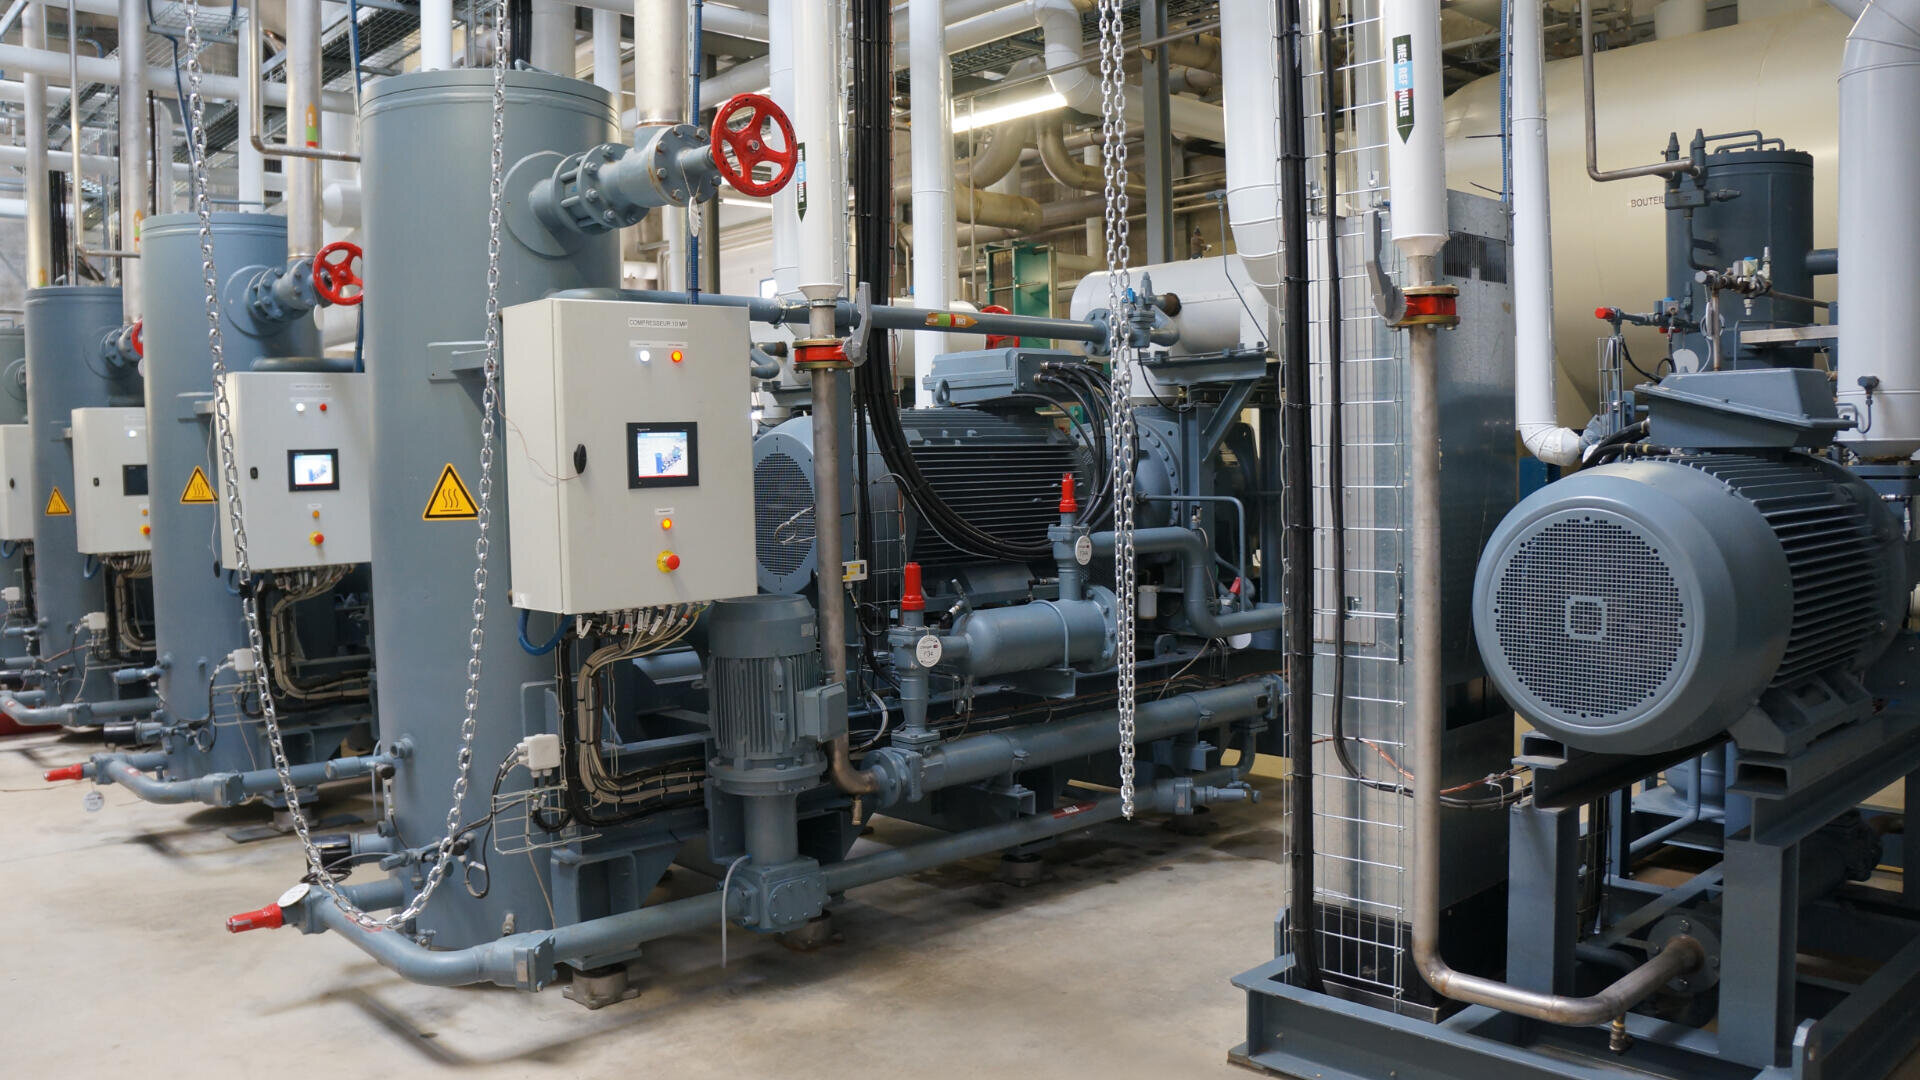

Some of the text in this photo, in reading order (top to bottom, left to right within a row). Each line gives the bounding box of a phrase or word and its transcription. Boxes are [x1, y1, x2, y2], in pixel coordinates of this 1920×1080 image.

[1397, 44, 1409, 117] MEG REF HUILE
